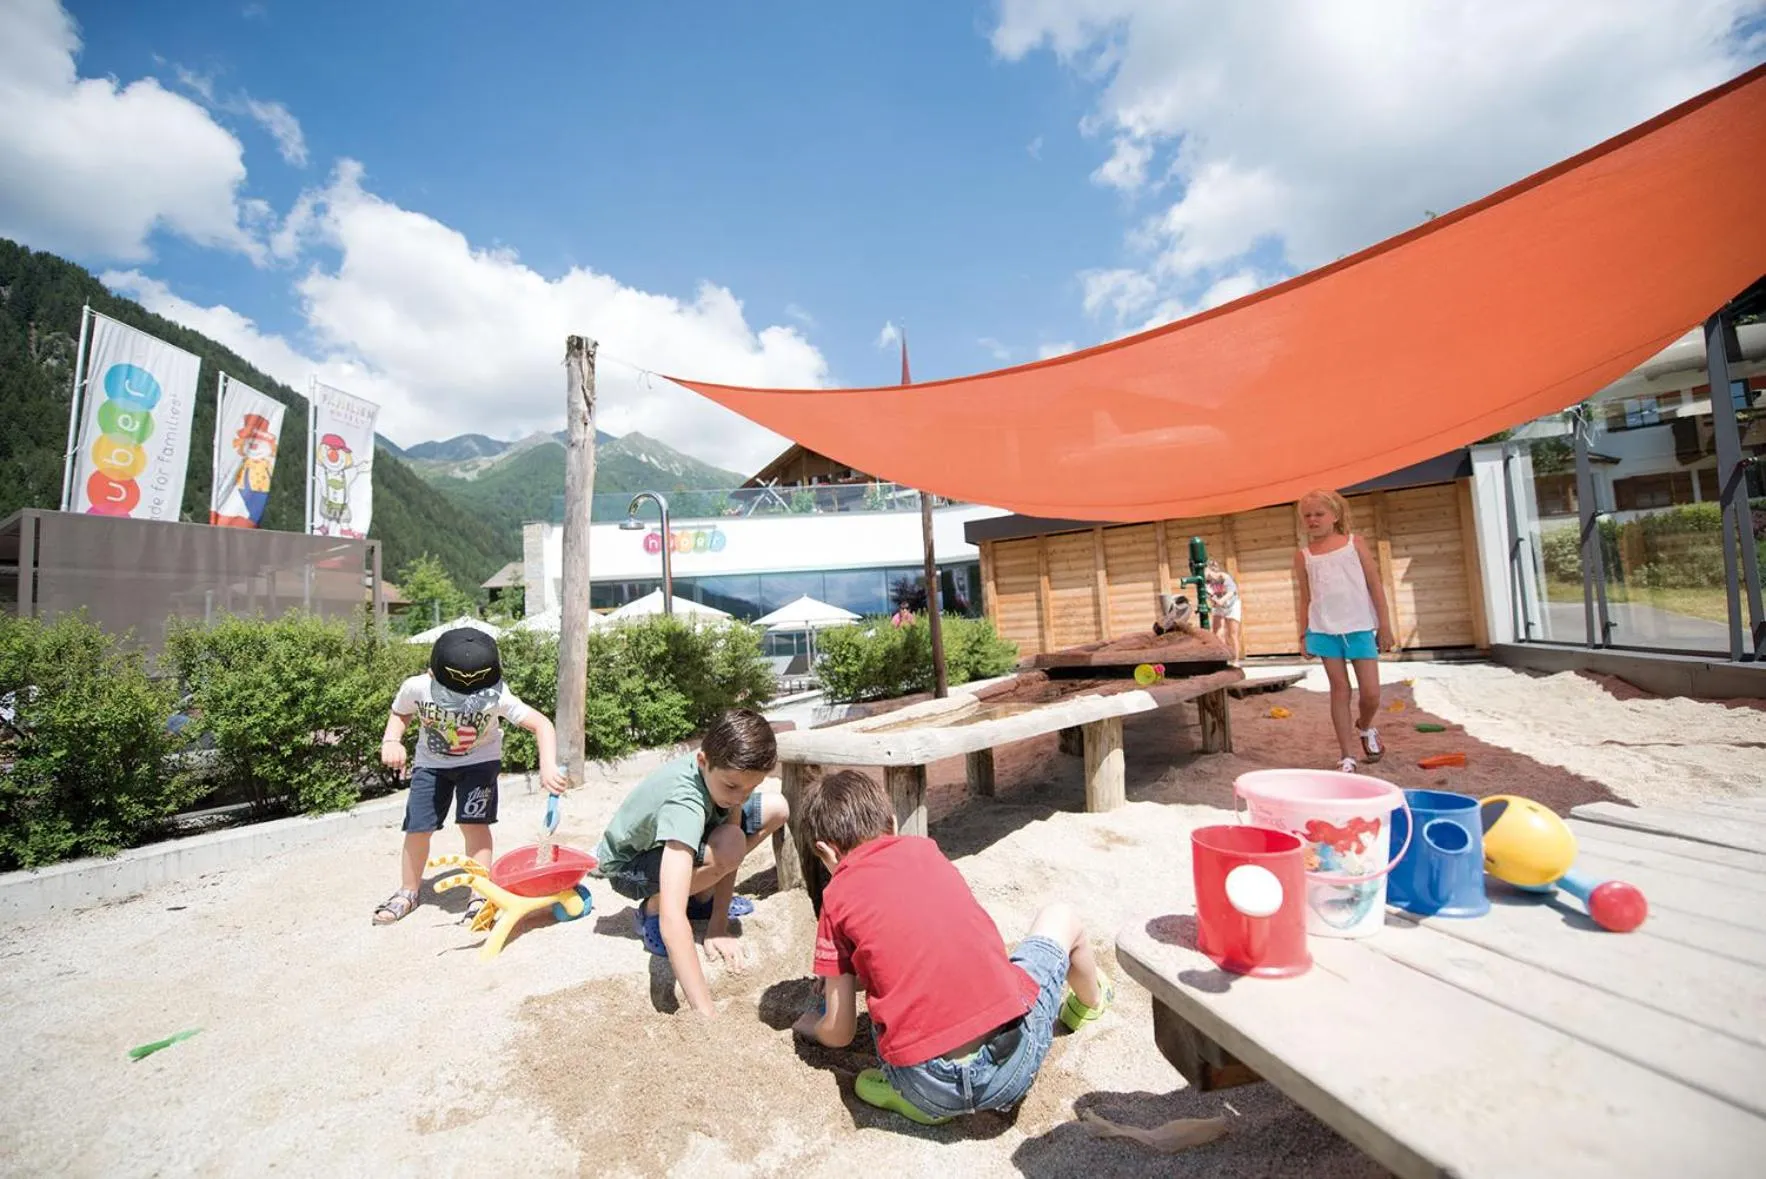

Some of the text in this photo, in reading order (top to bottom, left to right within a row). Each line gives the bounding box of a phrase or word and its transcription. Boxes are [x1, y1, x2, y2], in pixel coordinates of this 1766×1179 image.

[99, 375, 148, 508] uber
[150, 470, 169, 492] for
[464, 799, 487, 817] 62
